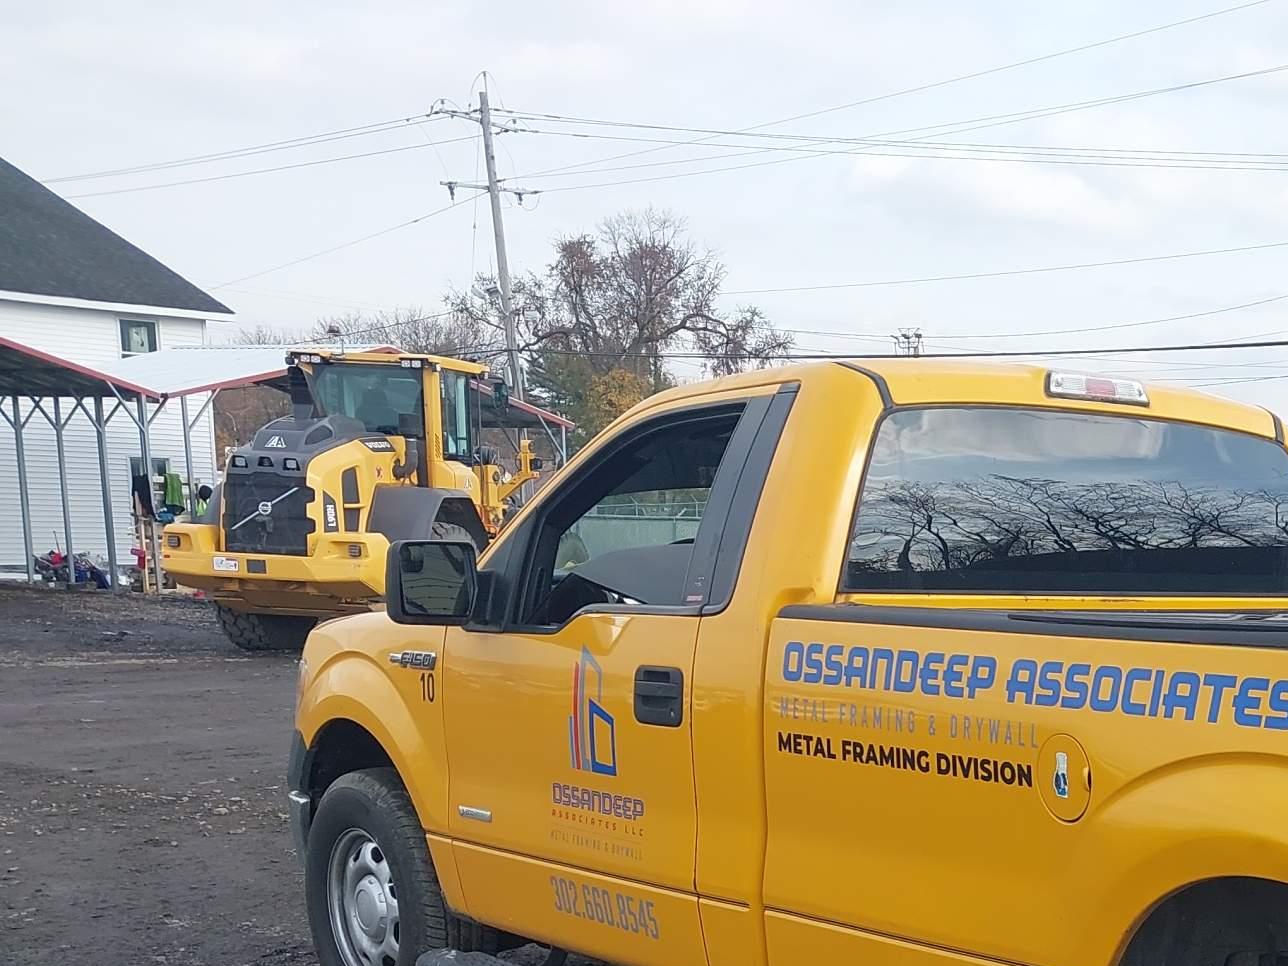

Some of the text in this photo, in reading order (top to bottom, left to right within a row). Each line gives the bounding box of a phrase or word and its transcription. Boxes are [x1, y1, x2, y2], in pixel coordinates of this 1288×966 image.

[420, 672, 435, 703] 10
[782, 641, 998, 700] OSSANDEEP
[780, 697, 1039, 749] METAL FRAMING & DRYWALL
[777, 731, 1033, 788] METAL FRAMING DIVISION
[551, 808, 645, 837] ASSOCIATES LLC
[552, 782, 645, 821] OSSANDEEP
[549, 875, 660, 940] 302.660.8545
